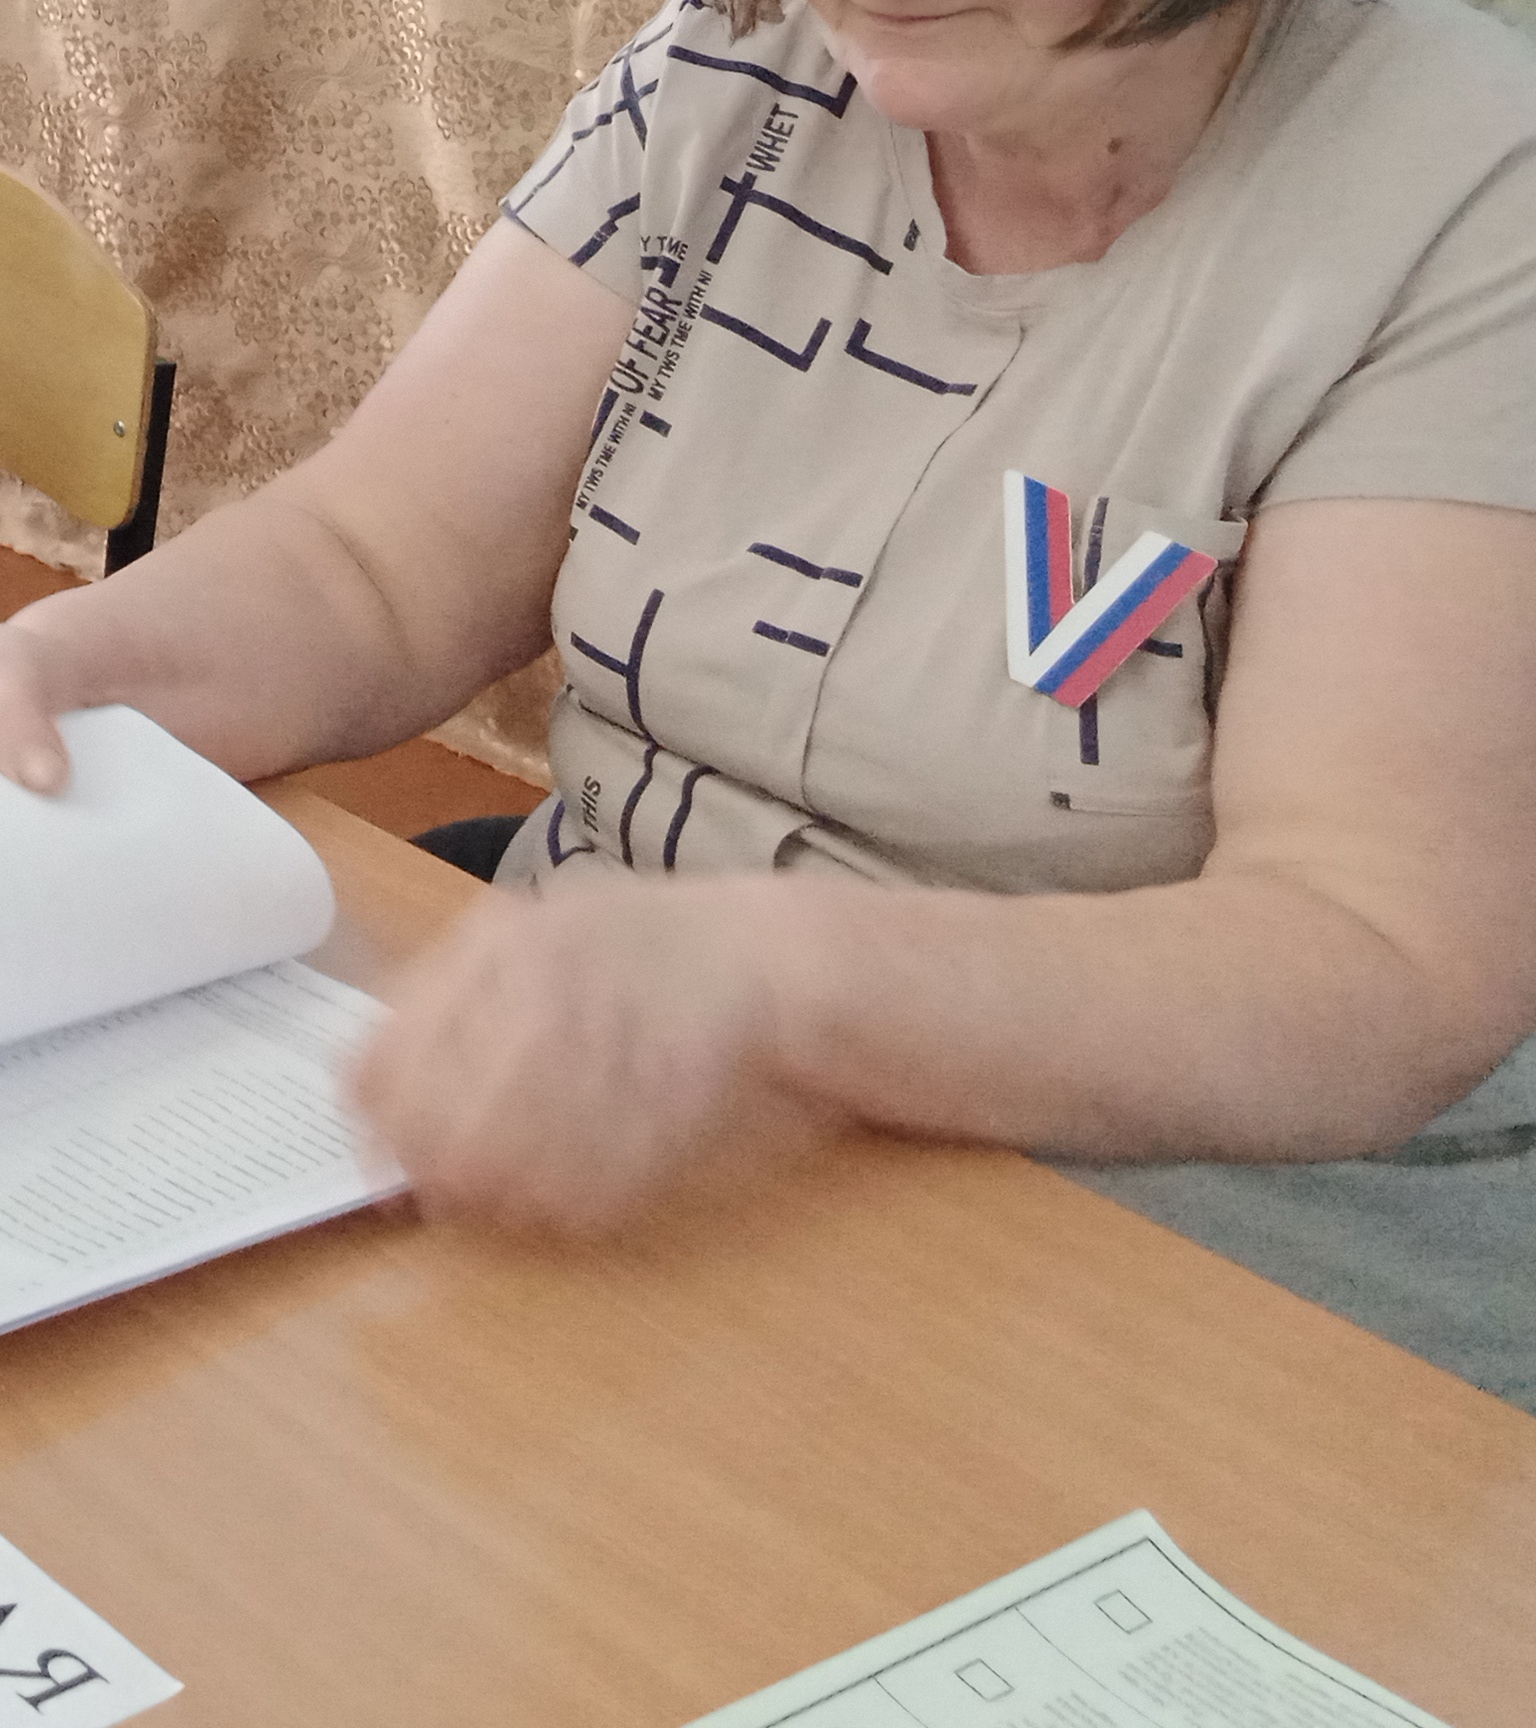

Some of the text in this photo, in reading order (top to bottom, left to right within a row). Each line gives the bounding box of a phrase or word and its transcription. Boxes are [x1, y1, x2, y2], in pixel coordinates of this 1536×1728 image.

[746, 103, 799, 172] WHET
[626, 286, 682, 361] FEAR
[581, 775, 601, 833] THIS
